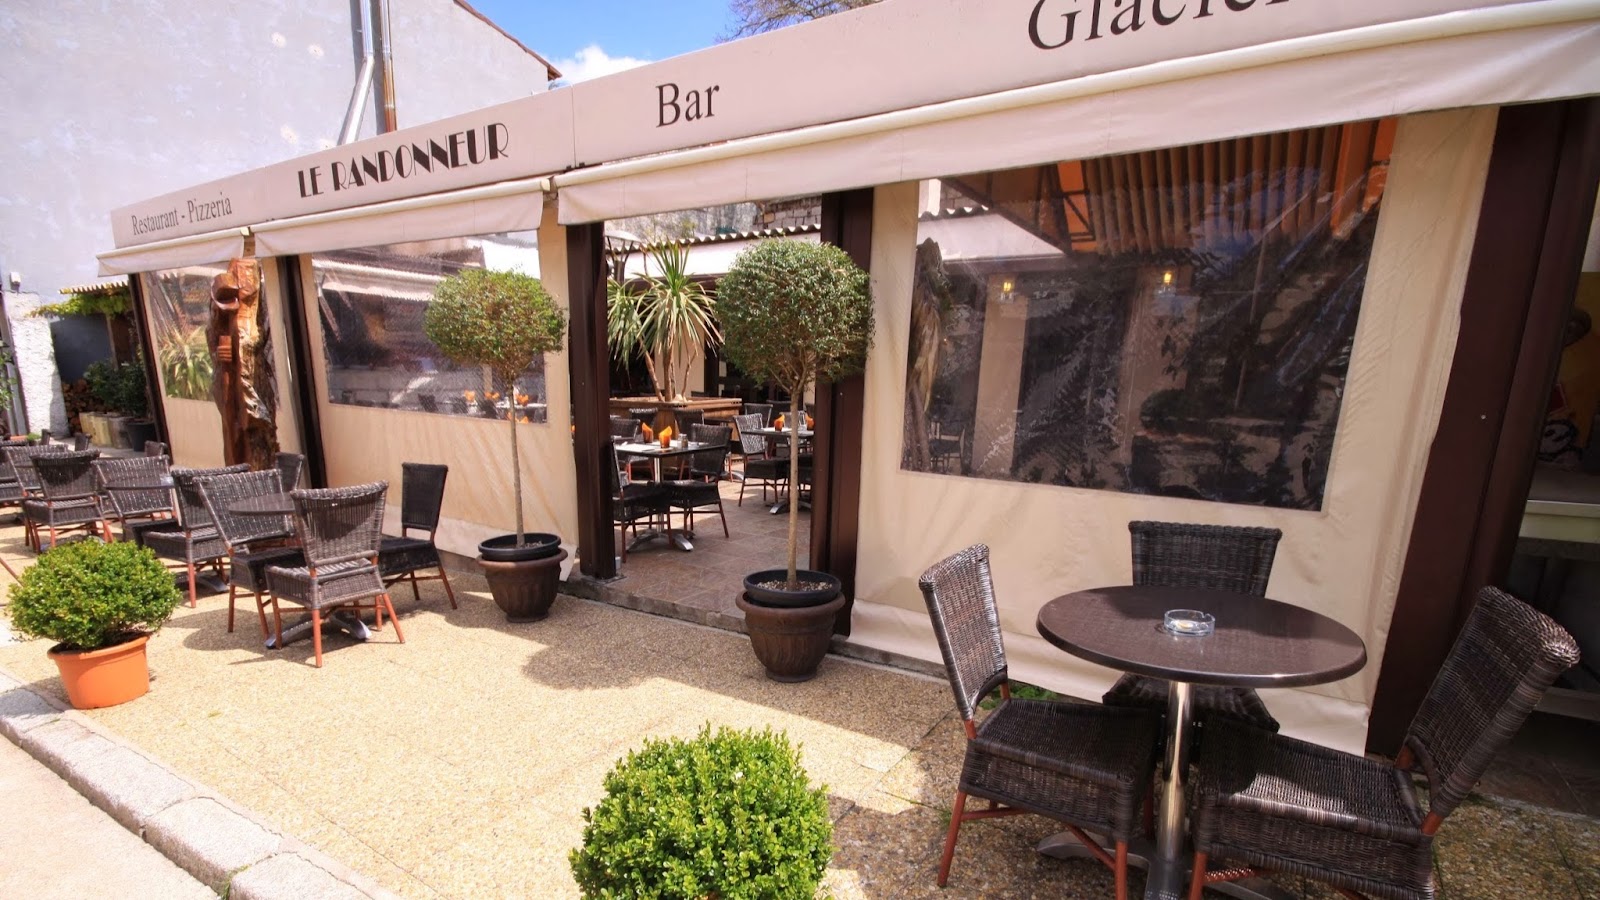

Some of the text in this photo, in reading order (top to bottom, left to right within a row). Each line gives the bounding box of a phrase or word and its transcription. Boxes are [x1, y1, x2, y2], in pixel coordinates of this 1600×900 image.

[1028, 0, 1290, 50] Glac
[655, 83, 720, 128] Bar
[298, 122, 510, 198] LE RANDONNEUR
[131, 208, 180, 236] Restaurant
[187, 191, 233, 224] Pizzeria
